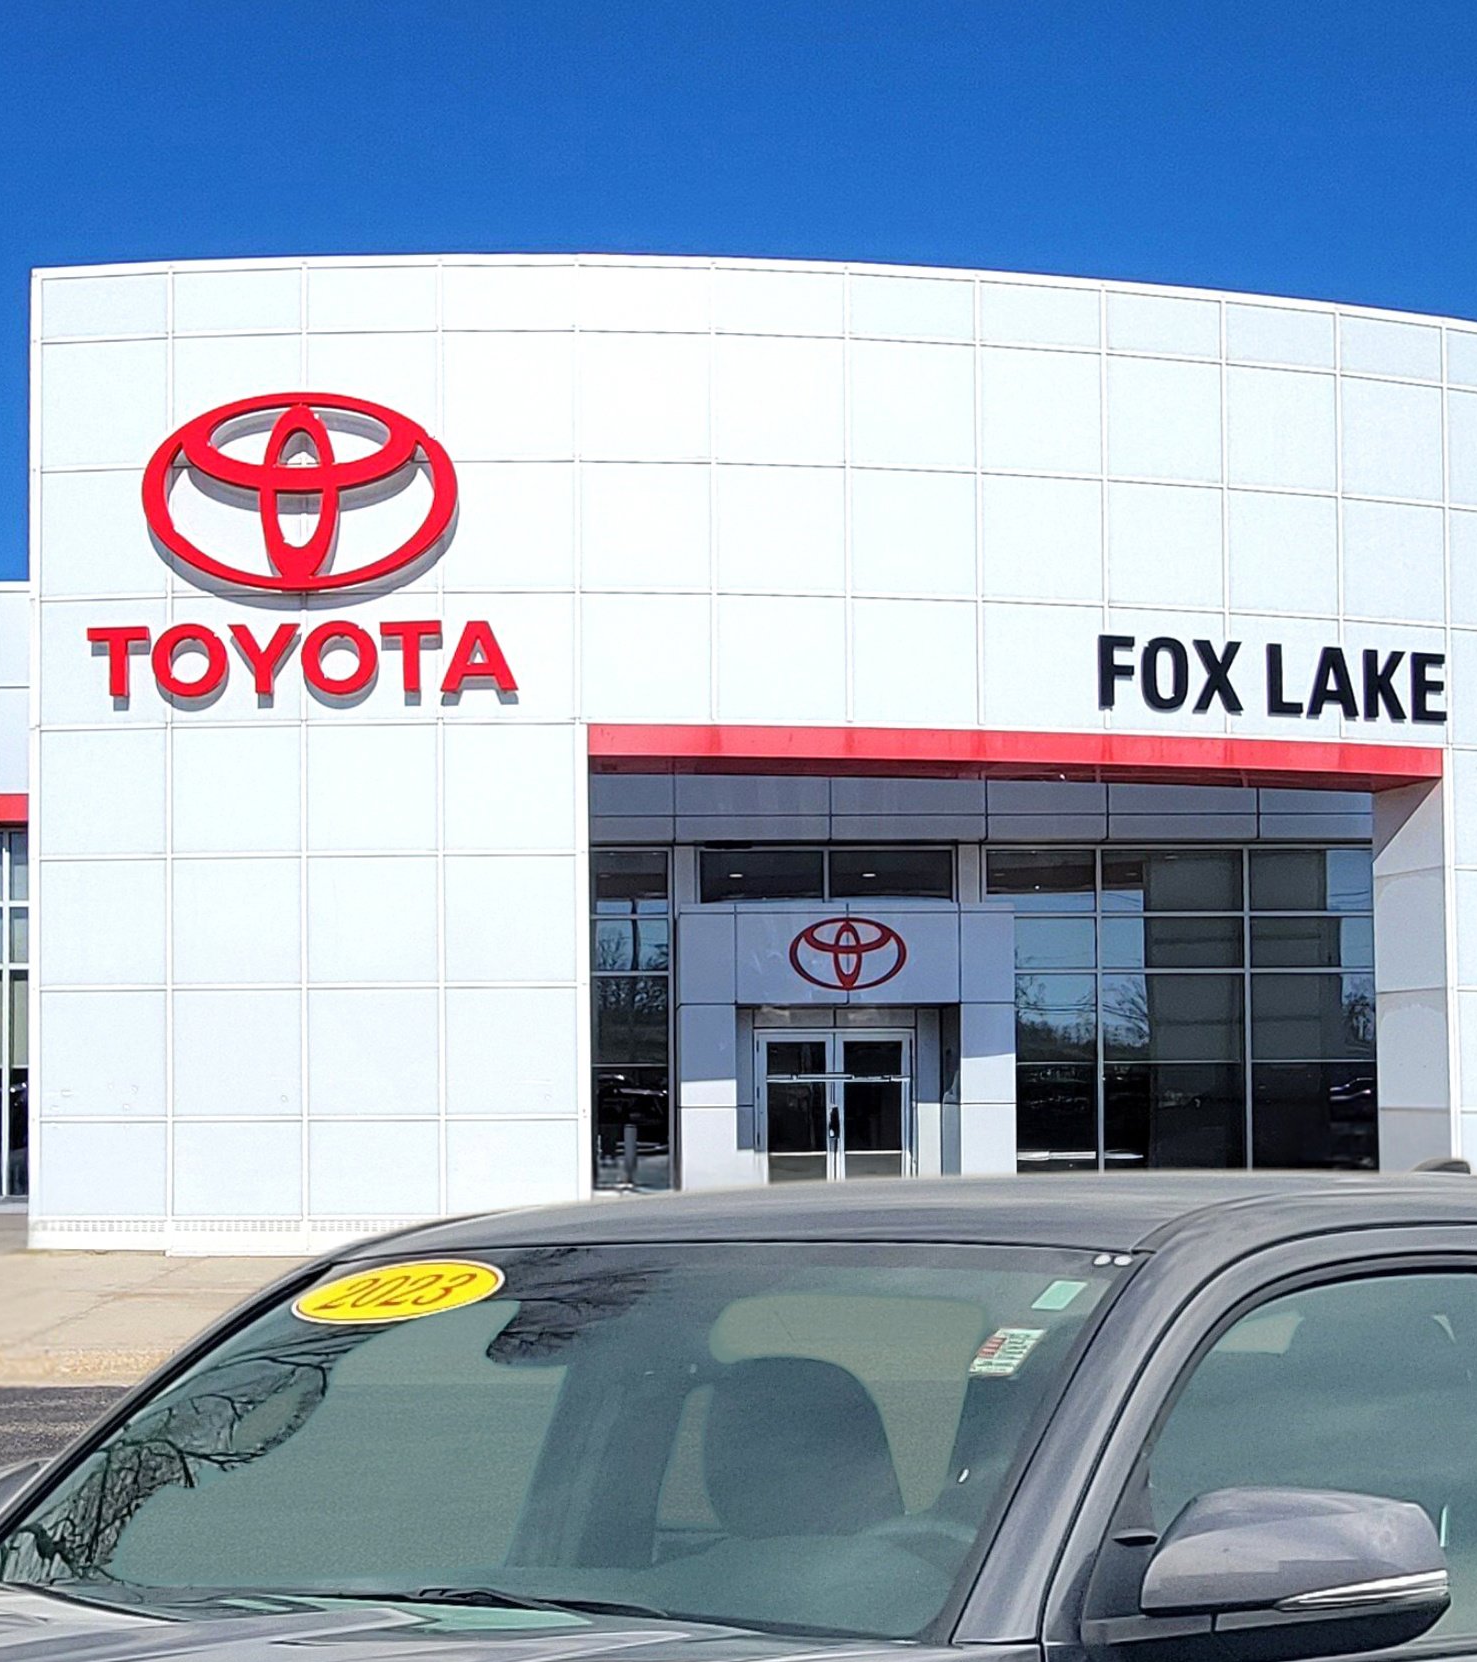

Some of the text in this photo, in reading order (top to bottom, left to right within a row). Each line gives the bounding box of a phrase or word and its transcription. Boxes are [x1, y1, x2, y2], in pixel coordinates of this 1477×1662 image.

[87, 620, 519, 699] TOYOTA
[1097, 634, 1447, 723] FOX LAKE
[313, 1273, 478, 1311] 2023
